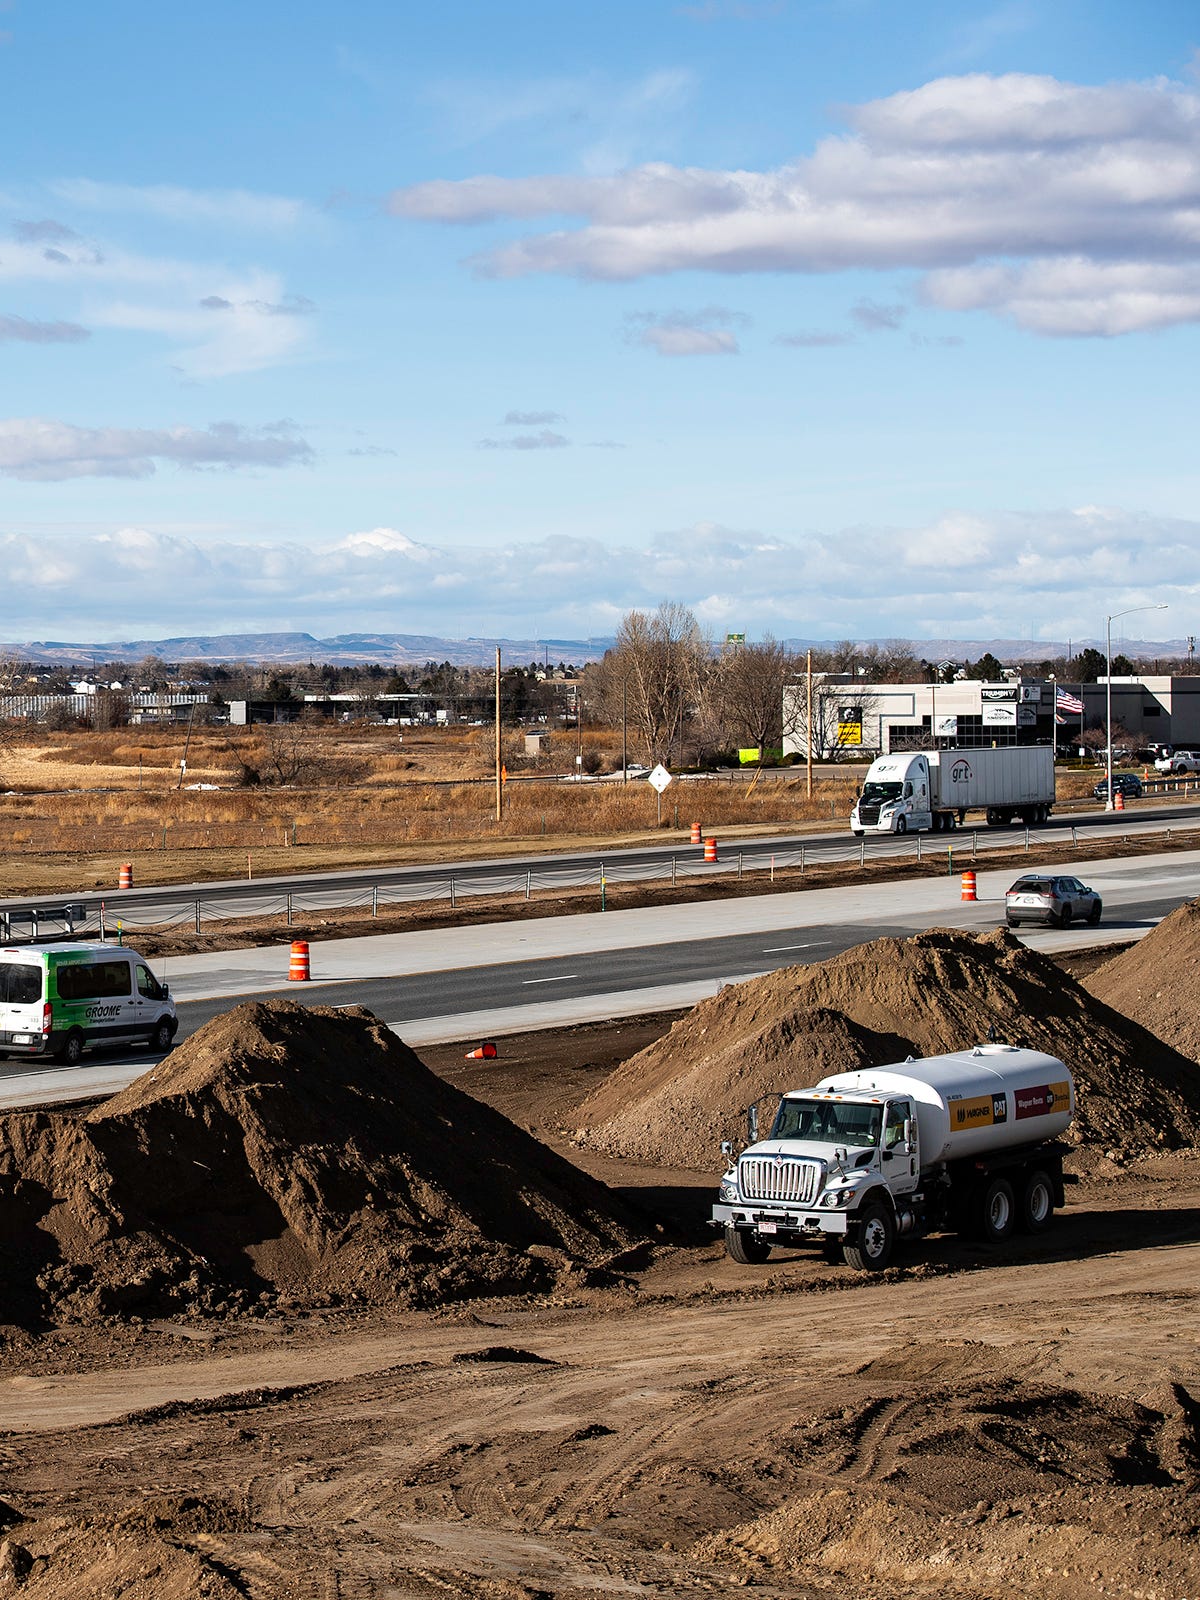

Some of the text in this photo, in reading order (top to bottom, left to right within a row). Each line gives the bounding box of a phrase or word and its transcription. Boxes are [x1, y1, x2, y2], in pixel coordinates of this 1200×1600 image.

[981, 690, 1009, 698] TRIUMPH
[85, 1005, 121, 1017] GROOME
[994, 1100, 1006, 1117] CAT
[1018, 1099, 1033, 1109] Wagner
[966, 1106, 990, 1118] WAGNER
